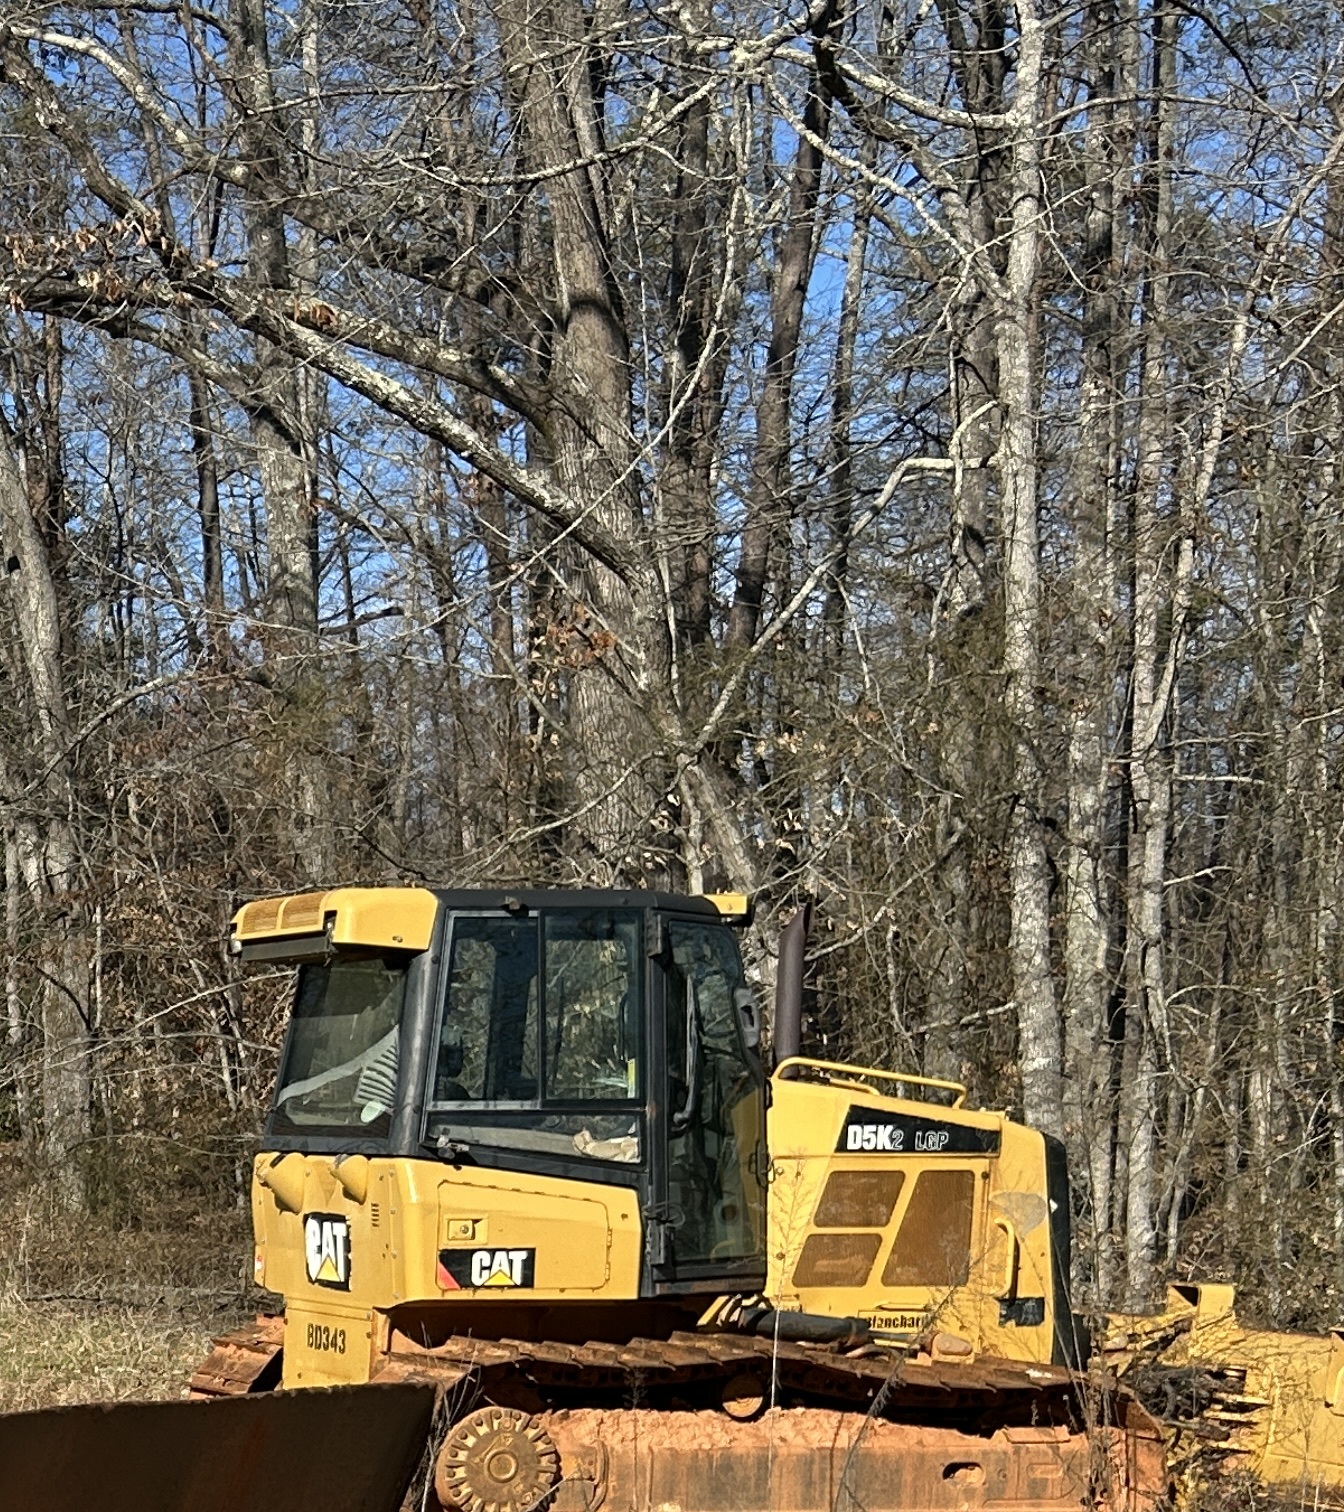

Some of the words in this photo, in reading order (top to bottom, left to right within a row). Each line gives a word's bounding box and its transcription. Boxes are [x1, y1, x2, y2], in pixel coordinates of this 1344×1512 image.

[846, 1124, 905, 1151] D5K2
[914, 1130, 950, 1151] LGP
[305, 1216, 348, 1284] CAT
[470, 1250, 528, 1287] CAT
[307, 1322, 347, 1355] BD343
